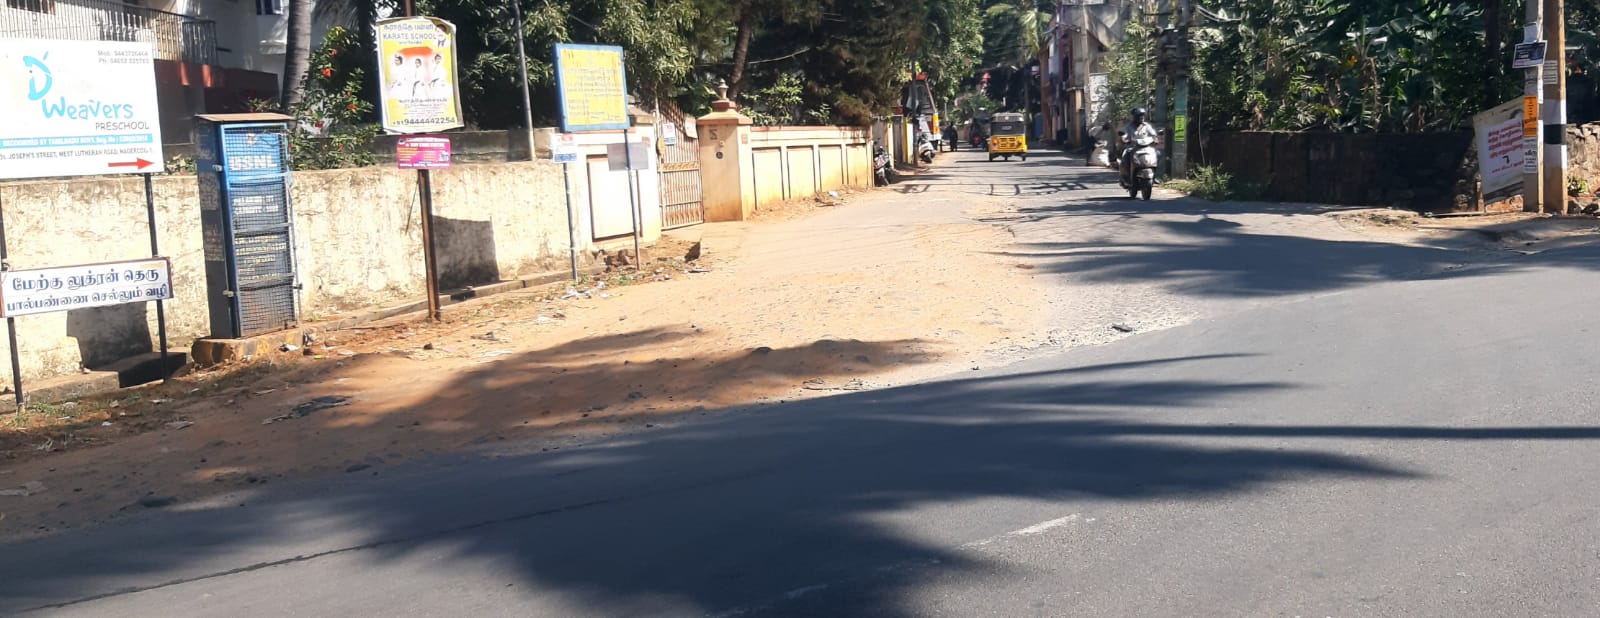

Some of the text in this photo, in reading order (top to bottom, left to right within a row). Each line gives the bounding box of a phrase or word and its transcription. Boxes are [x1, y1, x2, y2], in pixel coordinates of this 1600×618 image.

[410, 32, 437, 40] SCHOOL
[42, 96, 135, 120] Weavers
[95, 121, 150, 131] PRESCHOOL
[58, 150, 74, 158] WEST
[75, 148, 103, 157] LUTHERAN
[229, 155, 278, 171] BSNL
[12, 268, 160, 292] மேற்கு லுத்ரன் தெரு
[6, 283, 168, 312] பால்பண்ணை செல்லும் வழி
